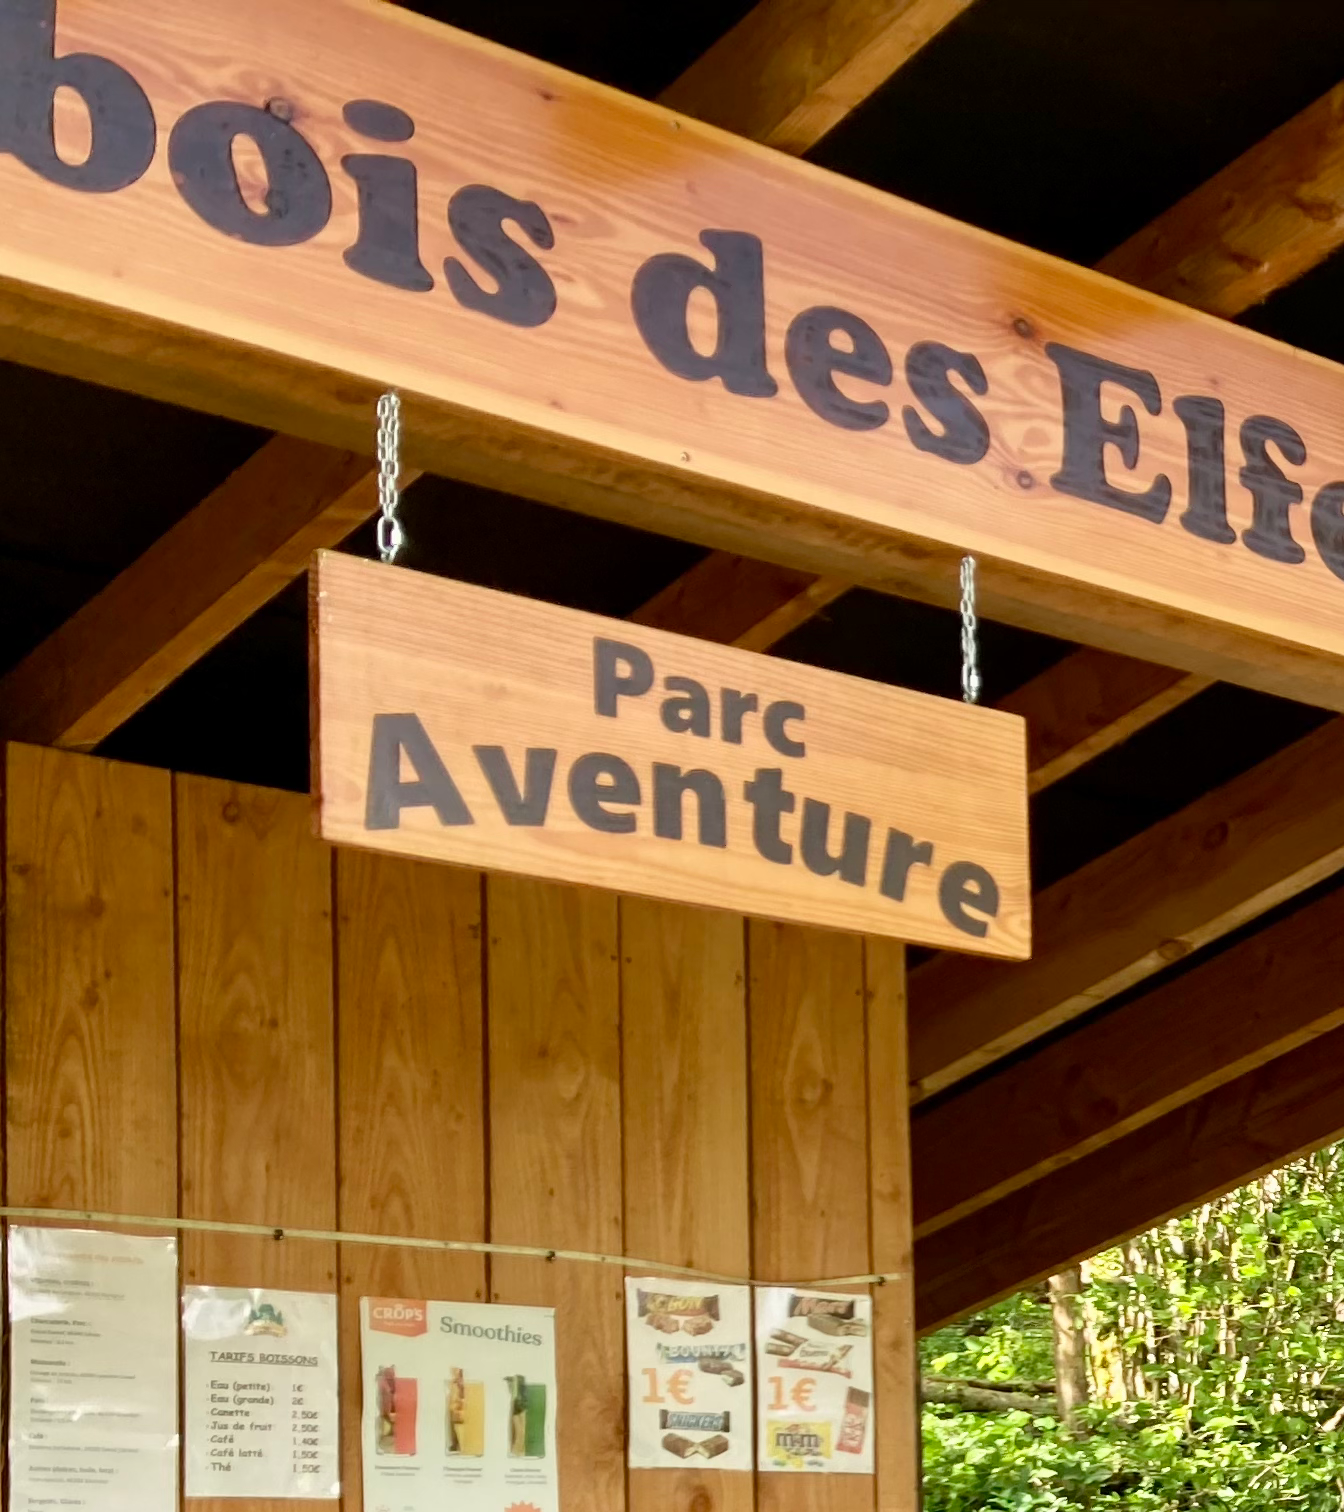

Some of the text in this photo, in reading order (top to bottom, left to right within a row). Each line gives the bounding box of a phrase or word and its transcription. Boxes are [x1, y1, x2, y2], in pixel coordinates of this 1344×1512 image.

[0, 0, 557, 327] bois
[630, 228, 990, 465] des
[593, 636, 806, 758] Parc
[364, 712, 1001, 938] Aventure
[440, 1316, 542, 1346] Smoothies
[210, 1351, 318, 1366] TARIFS BOISSONS
[210, 1380, 229, 1389] Eau
[233, 1381, 270, 1392] (petite)
[642, 1368, 695, 1405] 1€
[210, 1394, 229, 1403] Eau
[233, 1395, 274, 1406] (grande)
[768, 1376, 817, 1412] 1€
[210, 1408, 250, 1417] Canette
[210, 1421, 228, 1430] Jus
[233, 1422, 245, 1430] de
[249, 1422, 272, 1431] fruit
[210, 1435, 234, 1443] Café
[210, 1448, 234, 1457] Café
[210, 1462, 231, 1472] Thé
